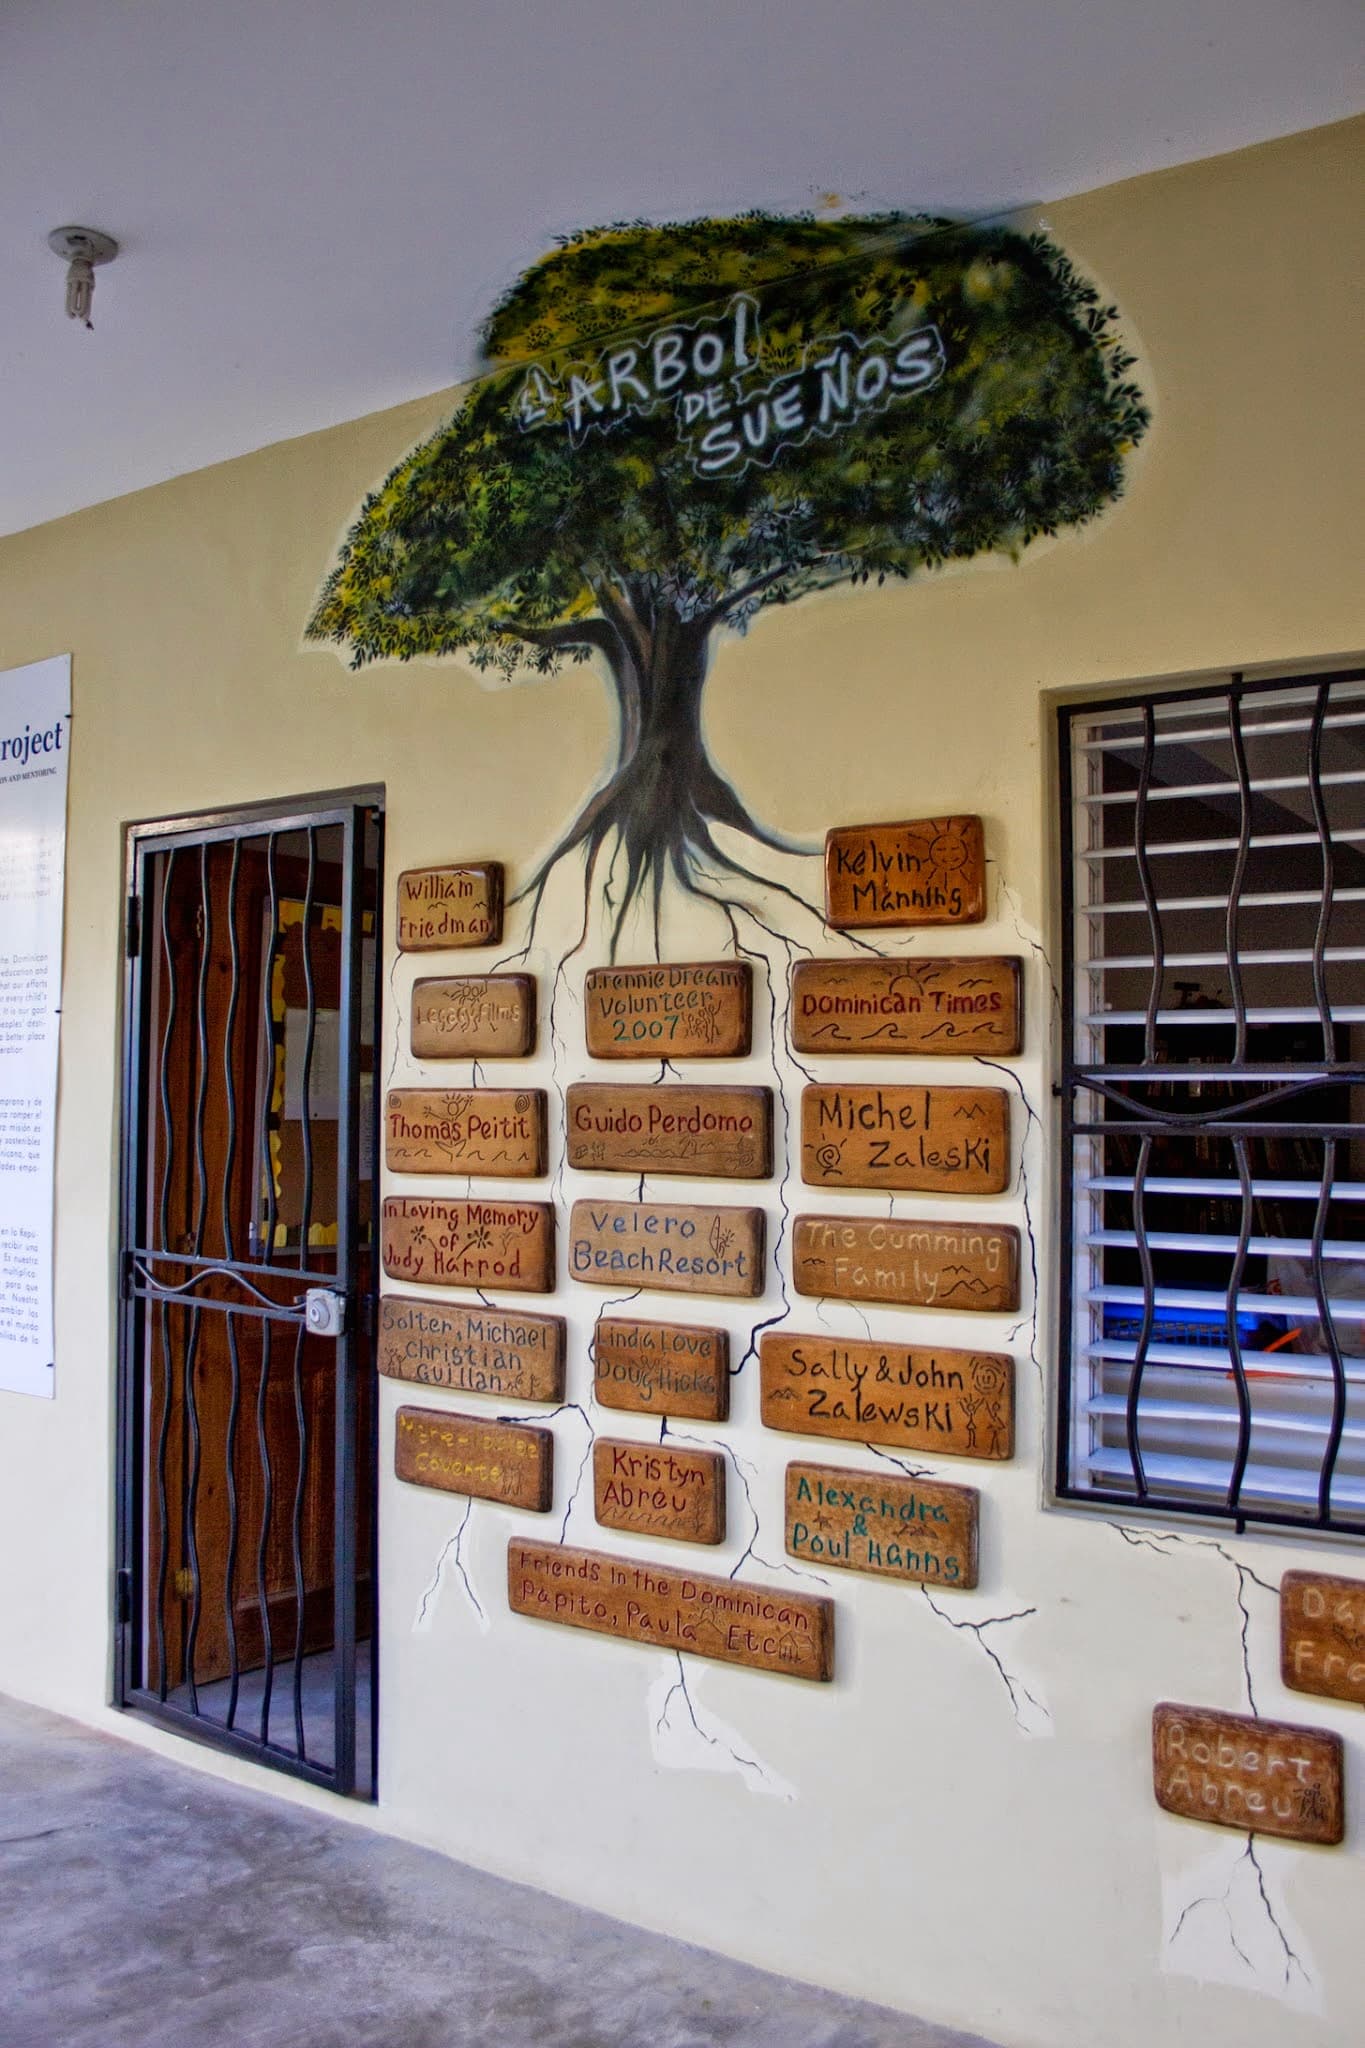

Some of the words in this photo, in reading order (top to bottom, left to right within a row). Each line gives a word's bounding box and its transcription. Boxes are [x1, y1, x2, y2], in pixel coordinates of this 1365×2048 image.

[683, 382, 731, 424] DE
[701, 340, 935, 469] SUEÑOS
[836, 839, 922, 876] Kelvin
[406, 874, 473, 900] William
[852, 880, 963, 916] Manning
[399, 912, 489, 938] Friedman
[600, 990, 713, 1018] Volunteer
[802, 992, 921, 1017] Dominican
[928, 990, 1003, 1014] Times
[612, 1015, 680, 1042] 2007
[390, 1114, 462, 1141] Thomas
[575, 1104, 642, 1133] Guido
[649, 1104, 753, 1134] Perdomo
[820, 1091, 931, 1130] Michel
[402, 1200, 459, 1232] Loving
[467, 1204, 539, 1234] Memory
[591, 1211, 695, 1239] Velero
[439, 1232, 459, 1251] of
[806, 1221, 857, 1248] The
[868, 1224, 1002, 1272] Cumming
[384, 1244, 423, 1276] Judy
[434, 1249, 521, 1278] Harrod
[834, 1257, 939, 1303] Family
[467, 1317, 547, 1350] Michael
[597, 1325, 655, 1348] Linda
[661, 1330, 711, 1357] Love
[406, 1340, 522, 1371] Christian
[789, 1349, 868, 1392] Sally
[876, 1355, 894, 1383] &
[900, 1354, 964, 1391] John
[597, 1354, 653, 1401] Doug
[613, 1447, 705, 1487] Kristyn
[603, 1481, 687, 1513] Abreu
[797, 1476, 949, 1524] Alexandra
[853, 1513, 868, 1536] &
[520, 1551, 601, 1581] Friends
[633, 1569, 670, 1596] the
[681, 1579, 808, 1630] Dominican
[626, 1600, 698, 1642] Paula
[727, 1624, 776, 1655] Etc
[1166, 1765, 1293, 1818] Abreu
